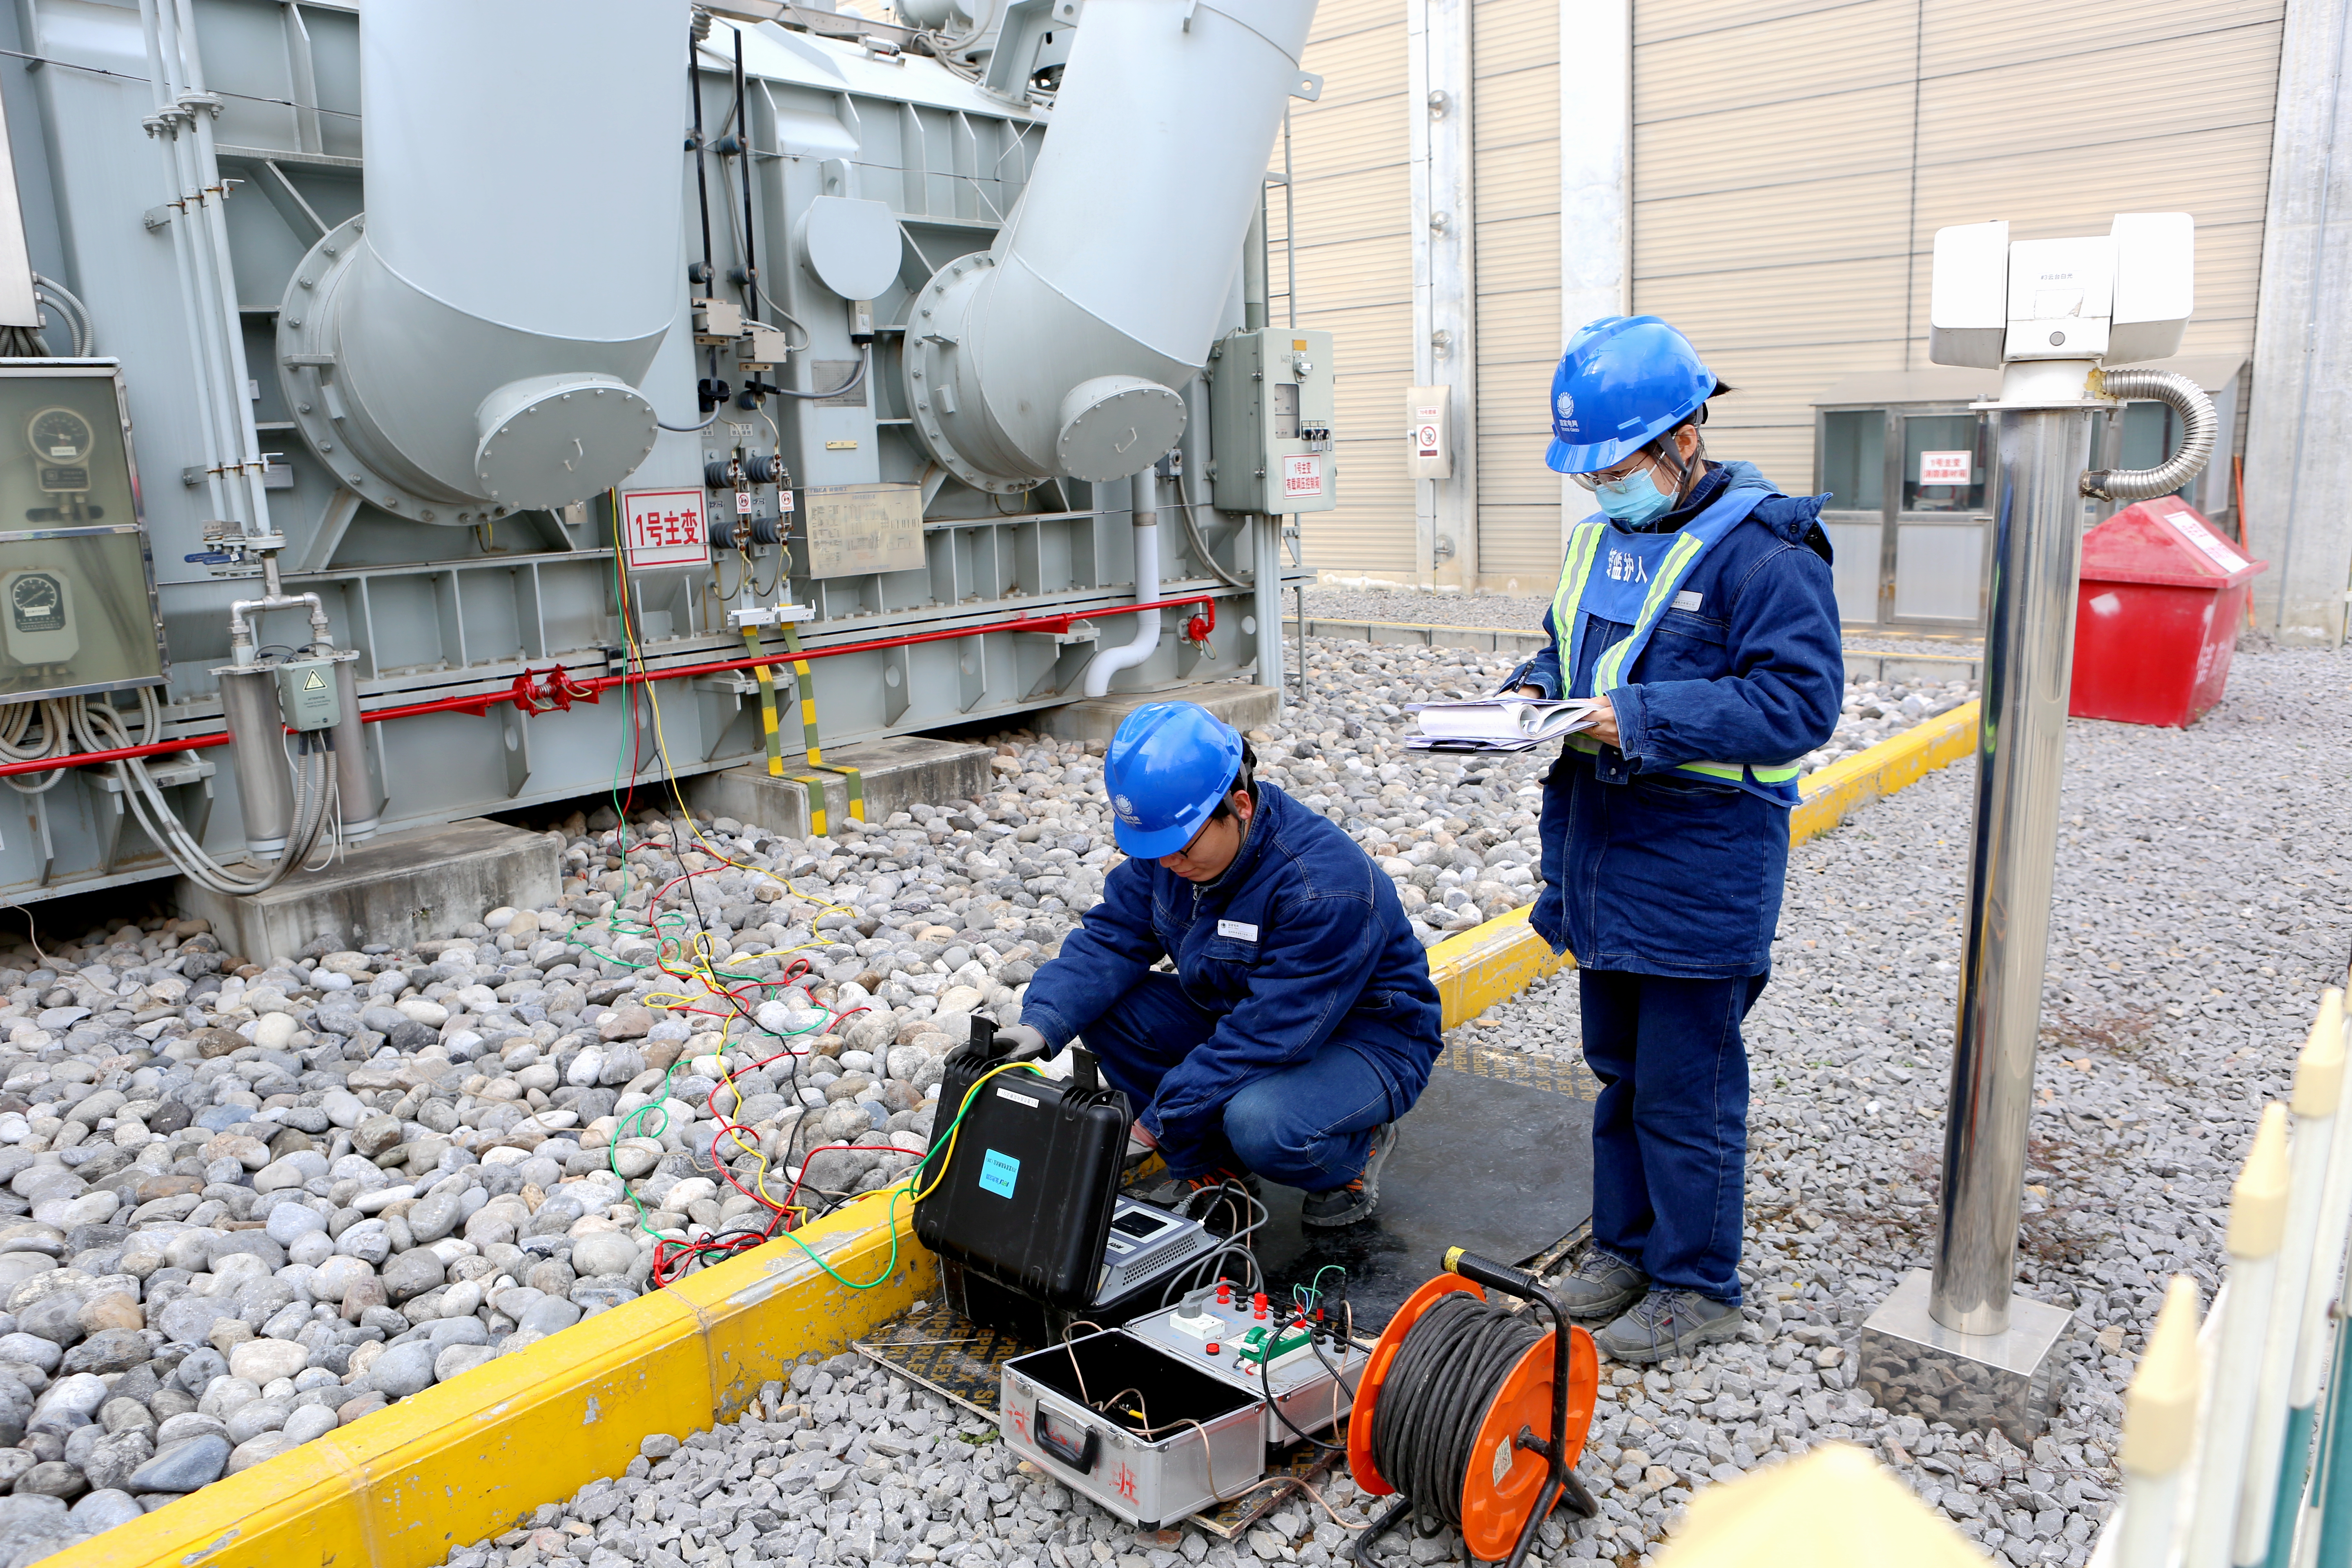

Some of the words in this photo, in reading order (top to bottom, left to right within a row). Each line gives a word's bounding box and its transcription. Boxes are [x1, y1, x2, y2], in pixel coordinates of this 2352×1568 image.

[1559, 419, 1578, 428] 国家电网
[1294, 461, 1312, 474] 1号主变
[636, 508, 699, 546] 1号主变
